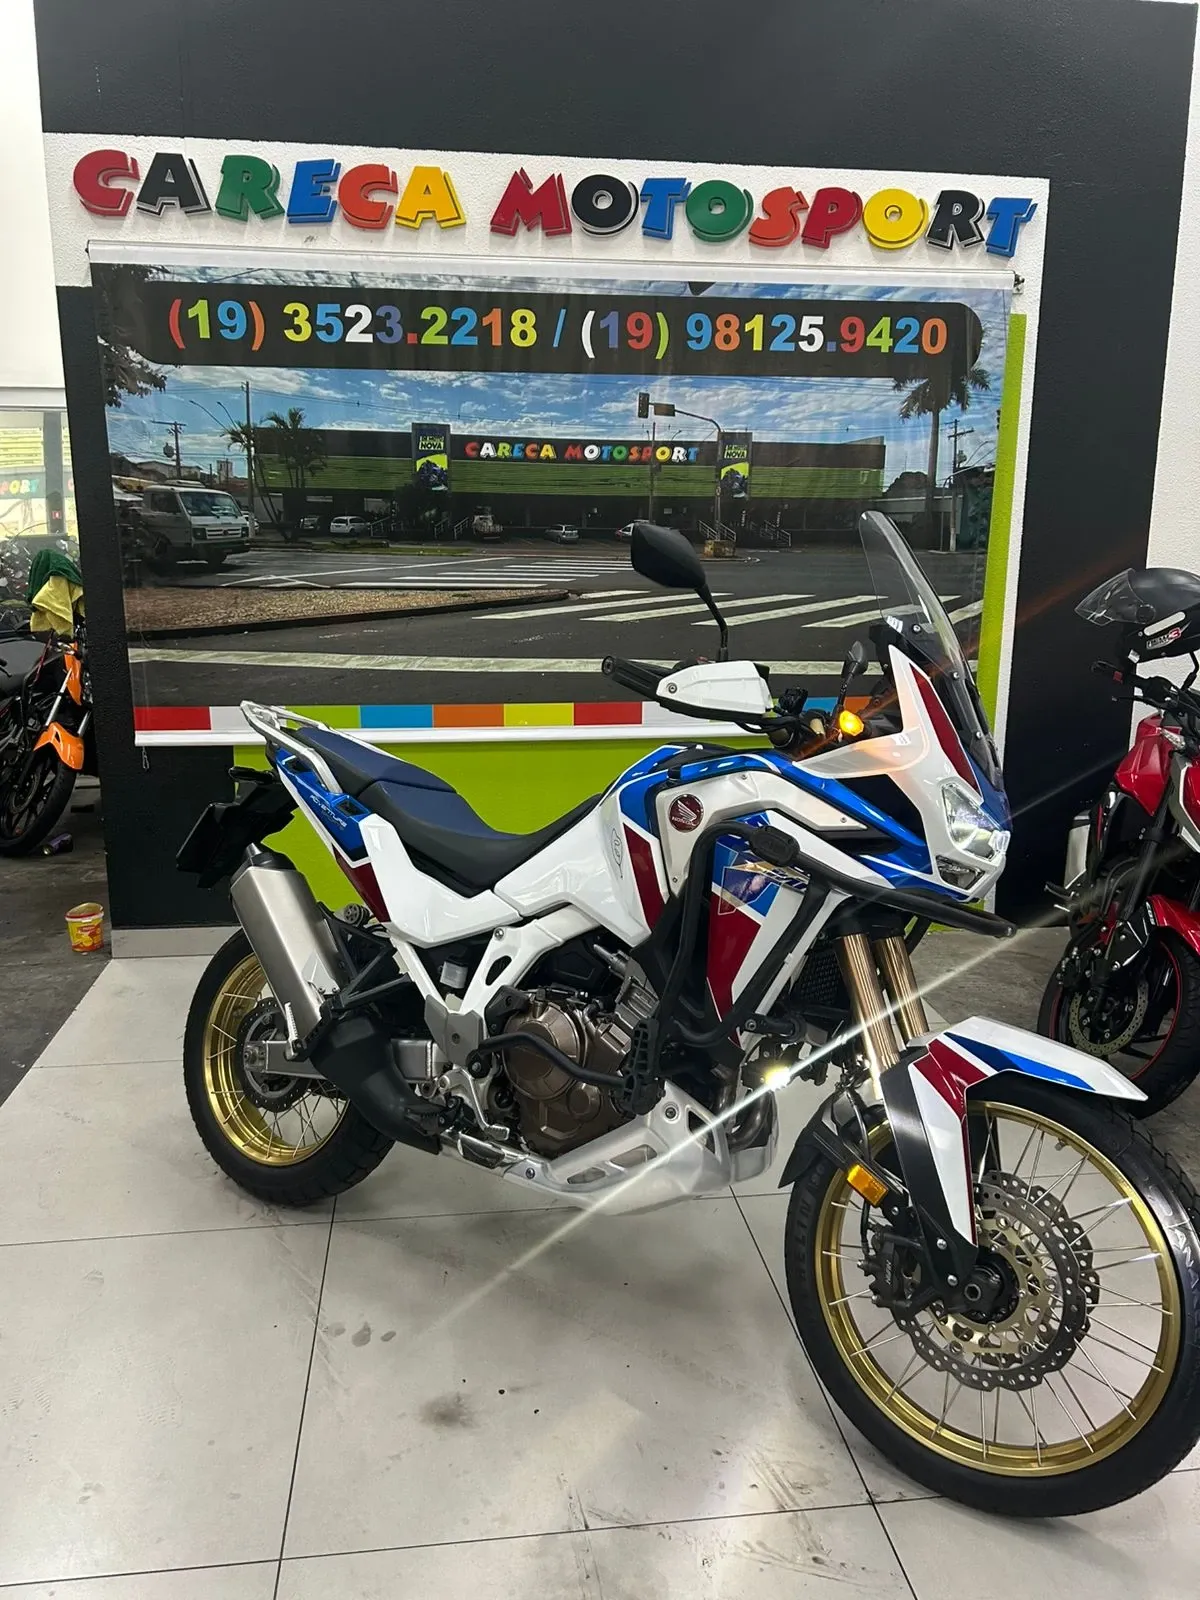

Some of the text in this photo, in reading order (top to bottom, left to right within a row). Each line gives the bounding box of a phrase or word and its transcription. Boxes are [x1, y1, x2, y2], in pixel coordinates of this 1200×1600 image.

[73, 149, 1037, 257] CARECA MOTOSPORT
[169, 299, 265, 350] (19)
[283, 302, 537, 347] 3523.2218
[581, 310, 670, 359] (19)
[686, 313, 948, 355] 98125.9420
[420, 441, 442, 449] NOVA
[464, 441, 699, 463] CARECA MOTOSPORT
